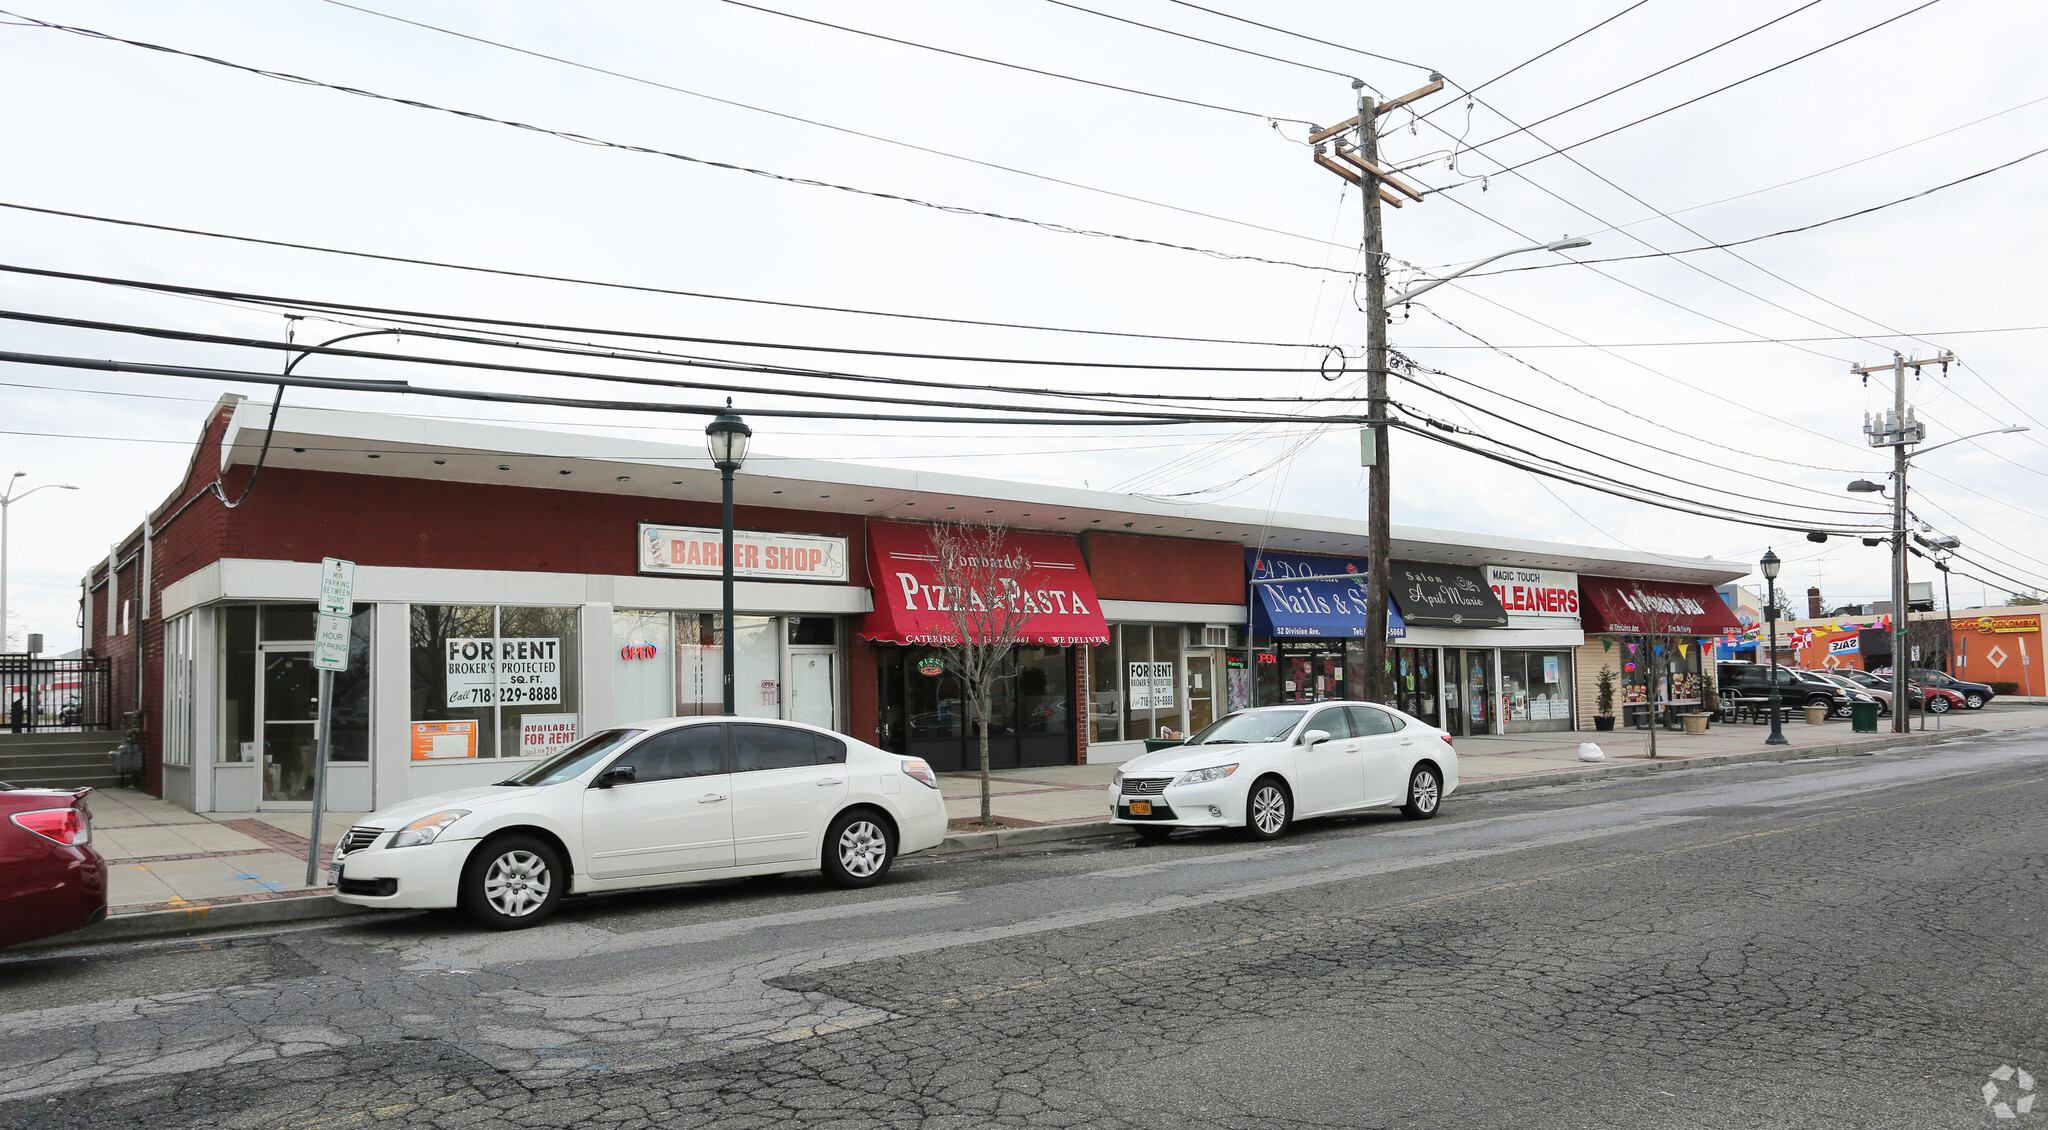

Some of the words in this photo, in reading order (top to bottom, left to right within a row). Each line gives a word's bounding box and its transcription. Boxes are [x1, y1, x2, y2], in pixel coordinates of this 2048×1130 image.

[766, 546, 822, 571] SHOP
[1406, 572, 1442, 583] Salon
[1493, 570, 1514, 580] MAGIC
[1517, 572, 1540, 582] TOUCH
[325, 579, 350, 588] PARKING
[323, 586, 350, 596] BETWEEN
[896, 572, 988, 612] PIZZA
[998, 578, 1090, 614] PASTA
[1409, 583, 1446, 607] April
[1440, 585, 1484, 606] Marie
[328, 595, 345, 604] SIGNS
[1264, 584, 1331, 614] Nails
[1333, 594, 1350, 615] &
[1992, 619, 2039, 627] COLOMBIA
[322, 632, 343, 640] HOUR
[906, 634, 958, 643] CATERING
[1068, 636, 1108, 644] DELIVER
[318, 642, 346, 652] PARKING
[450, 641, 494, 660] FOR
[502, 641, 556, 660] RENT
[622, 646, 656, 660] OPEN
[449, 663, 495, 674] BROKER'S
[502, 662, 556, 673] PROTECTED
[1131, 664, 1148, 677] FOR
[510, 676, 528, 684] SQ.
[450, 690, 469, 702] Call
[525, 724, 576, 732] AVAILABLE
[525, 734, 544, 745] FOR
[549, 733, 575, 744] RENT
